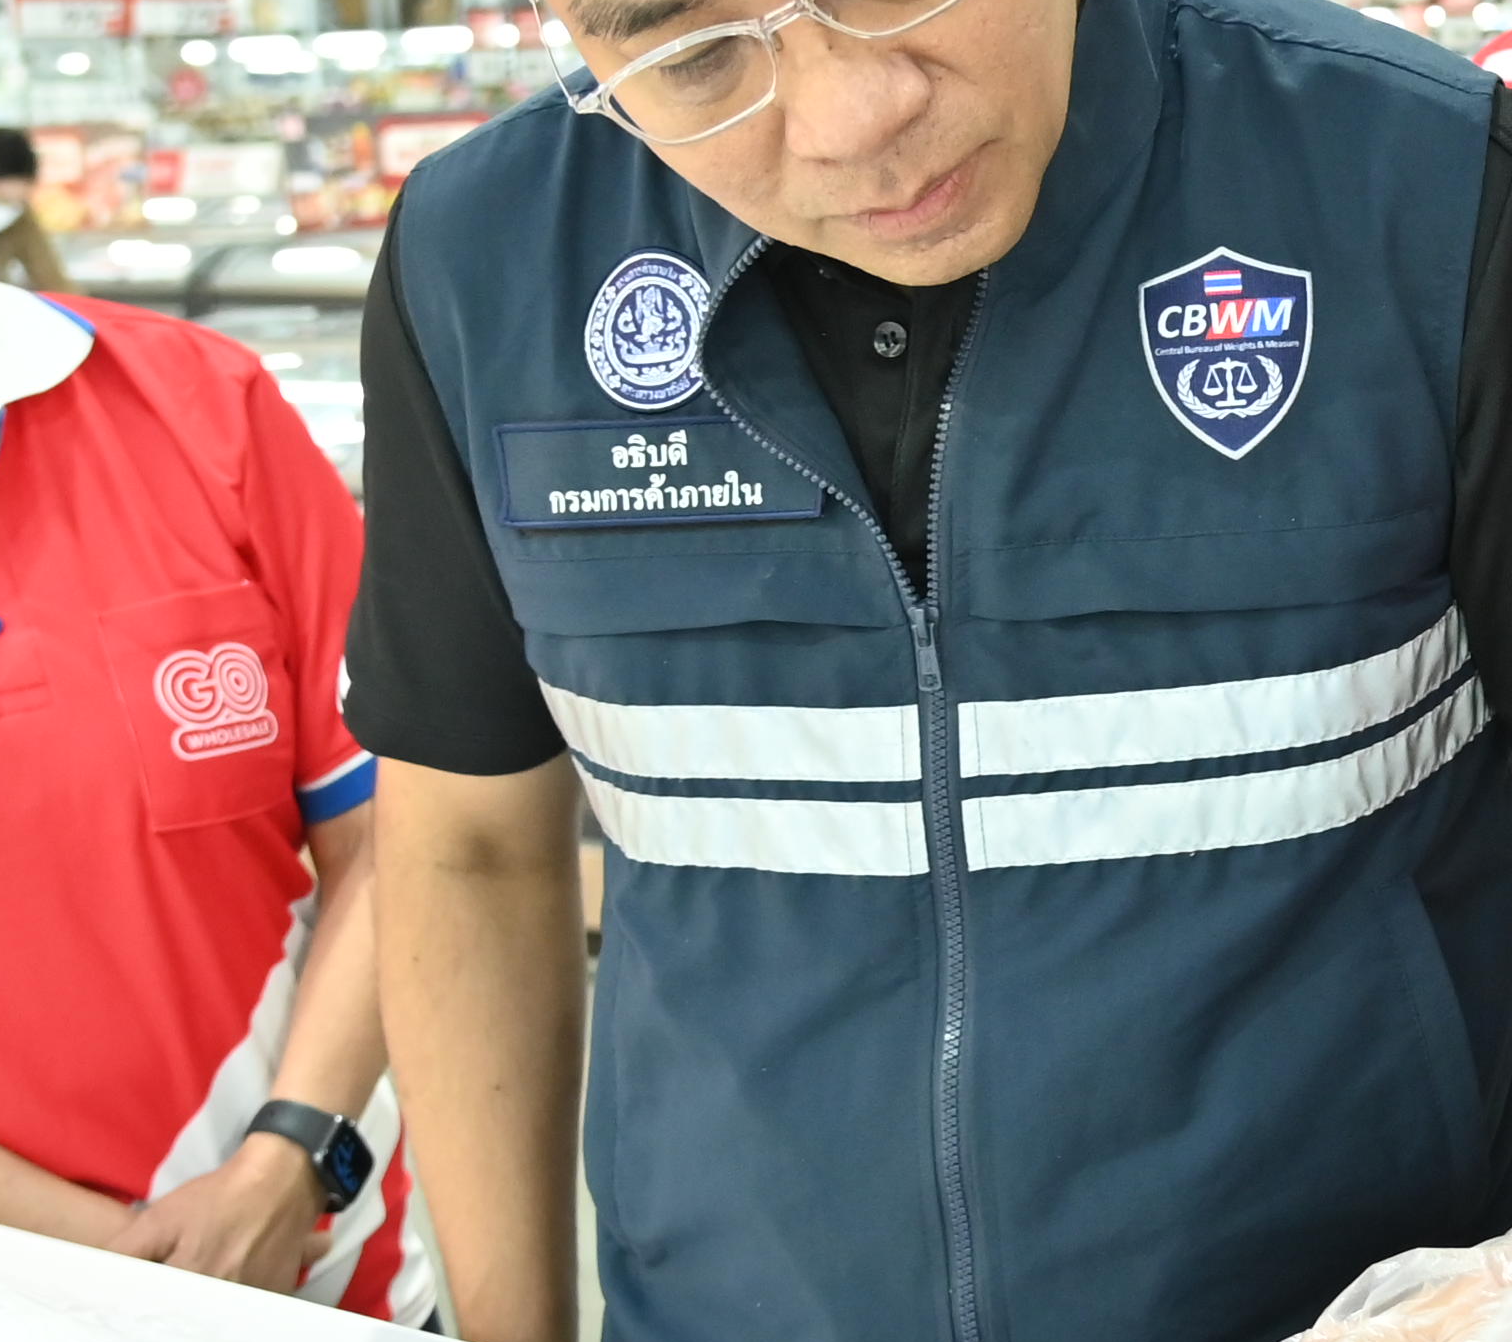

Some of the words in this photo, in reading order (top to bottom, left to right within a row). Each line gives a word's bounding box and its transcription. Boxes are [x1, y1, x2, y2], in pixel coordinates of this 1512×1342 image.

[1157, 299, 1293, 339] CBWM
[1155, 346, 1183, 356] Central
[1185, 345, 1214, 354] Bureau
[1215, 343, 1223, 351] of
[1224, 342, 1256, 351] Weights
[611, 429, 688, 469] อธิบดี
[548, 470, 763, 514] กรมการค้าภายใน
[153, 642, 269, 726] GO
